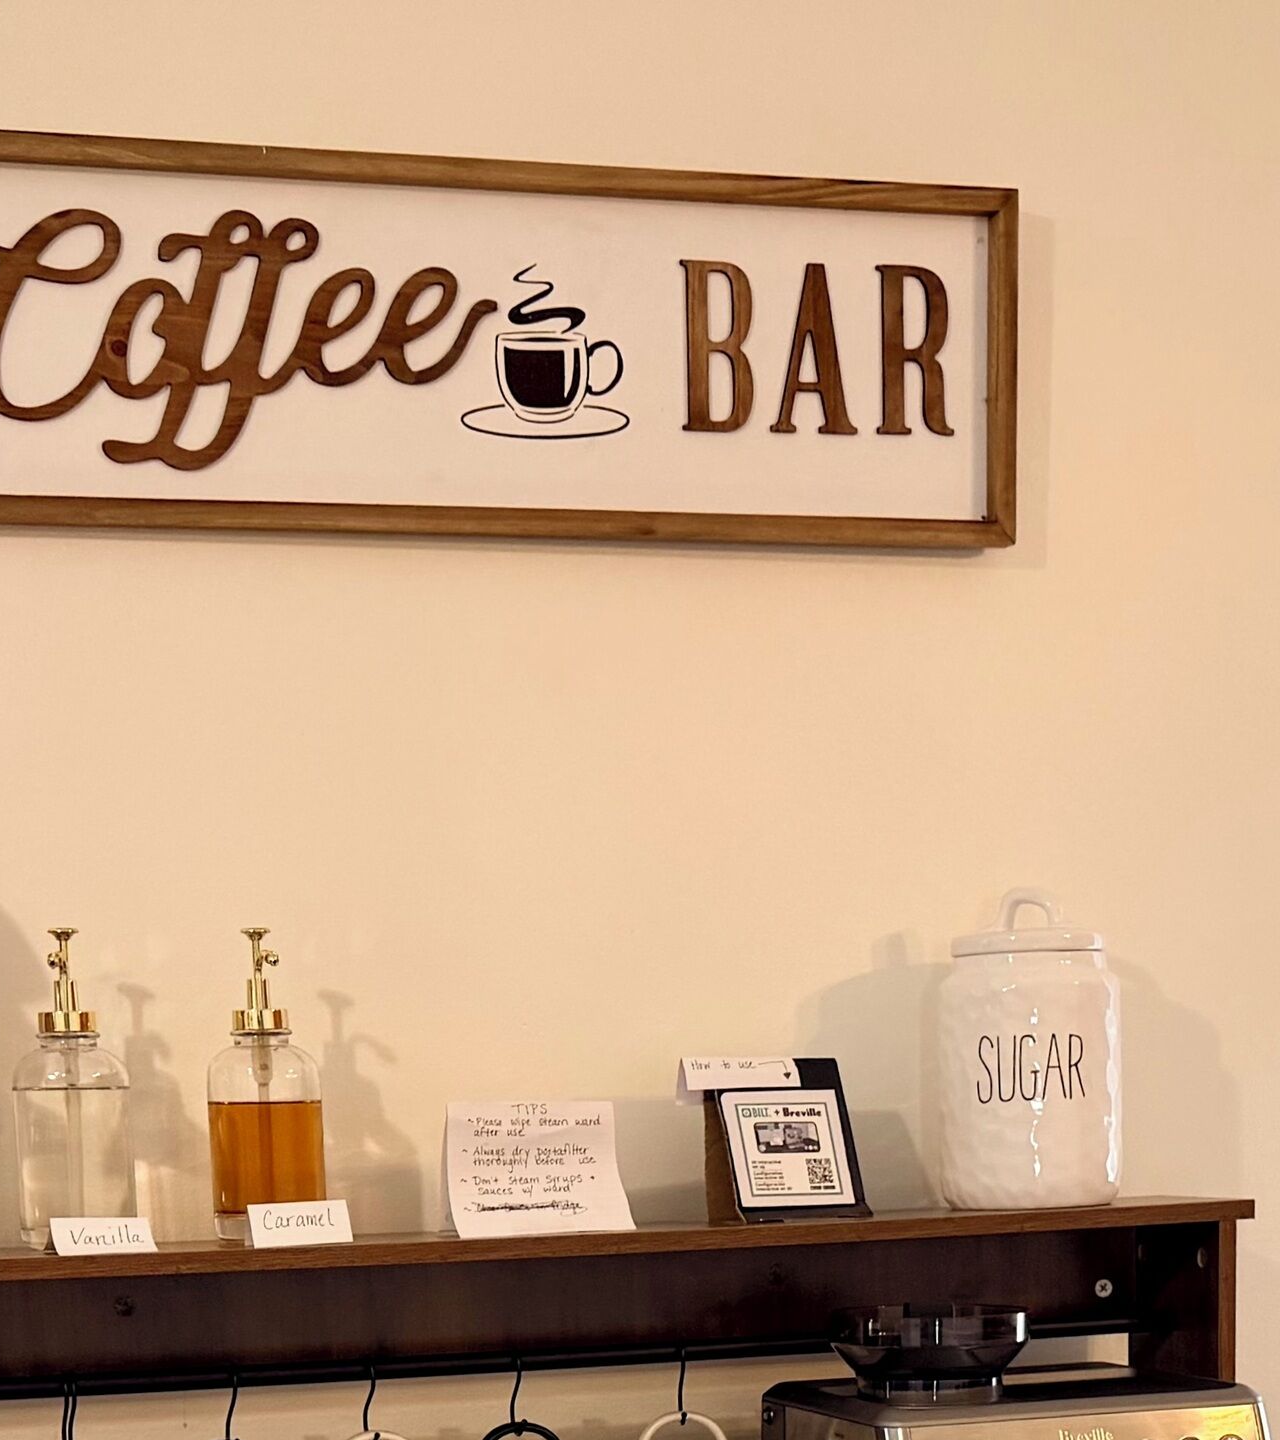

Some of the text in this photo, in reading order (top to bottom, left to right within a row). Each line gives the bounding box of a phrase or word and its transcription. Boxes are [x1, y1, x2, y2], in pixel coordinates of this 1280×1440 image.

[679, 258, 955, 438] BAR
[691, 1059, 757, 1070] How to use
[977, 1033, 1086, 1104] SUGAR
[511, 1103, 548, 1115] TIPS
[782, 1107, 822, 1117] Breville
[476, 1116, 503, 1126] Please
[511, 1117, 531, 1128] wipe
[539, 1115, 569, 1126] steam
[474, 1128, 526, 1138] after use
[473, 1146, 505, 1157] Always
[512, 1145, 531, 1158] dry
[535, 1155, 565, 1165] before
[472, 1175, 499, 1186] Don't
[508, 1175, 539, 1185] steam
[477, 1186, 514, 1195] sauces
[263, 1208, 335, 1230] Caramel
[70, 1224, 145, 1246] Vanilla
